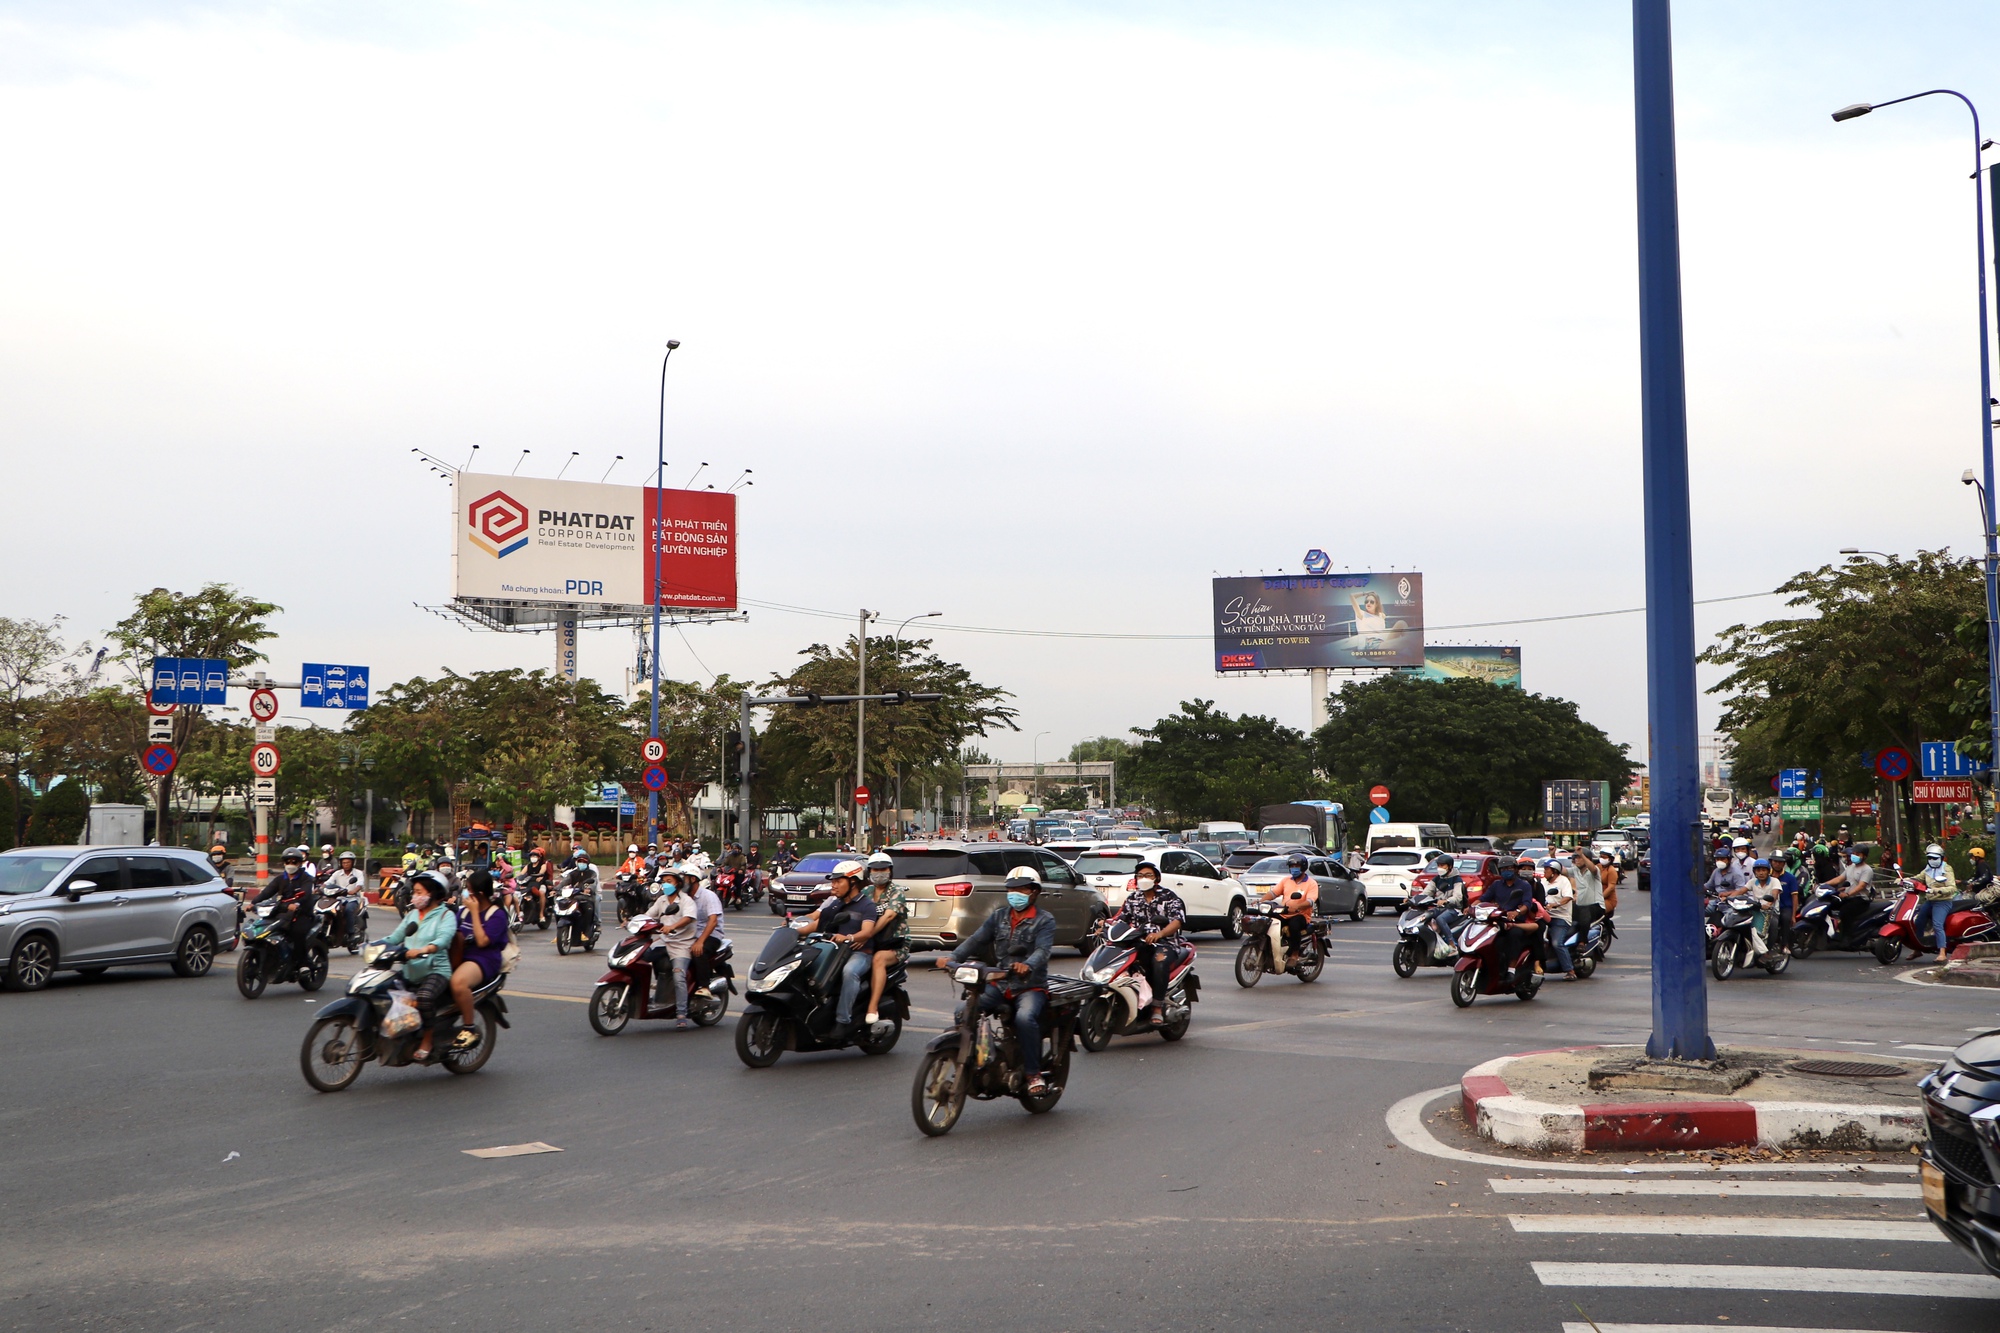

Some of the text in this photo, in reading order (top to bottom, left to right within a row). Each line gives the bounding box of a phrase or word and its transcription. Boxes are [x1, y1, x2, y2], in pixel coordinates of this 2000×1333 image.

[538, 510, 635, 531] PHATDAT
[674, 519, 699, 530] PHÁT
[701, 519, 728, 532] TRIỂN
[538, 528, 635, 542] CORPORATION
[674, 531, 704, 544] ĐỘNG
[706, 533, 728, 545] SẢN
[538, 539, 635, 551] Real Estate Development
[652, 543, 728, 558] CHUYÊN NGHIỆP
[539, 586, 564, 595] khoán:
[565, 579, 603, 596] PDR
[1328, 578, 1371, 589] GROUP
[660, 593, 726, 602] ww.phatdat.com.vn
[1240, 612, 1326, 626] NGÔI NHÀ THỨ 2
[1223, 626, 1242, 635] MẶT
[1308, 623, 1326, 631] TÀU
[1240, 636, 1311, 646] ALARIC TOWER
[648, 745, 660, 756] 50
[257, 752, 272, 768] 80
[1914, 783, 1970, 798] CHÚ Ý QUAN SÁT
